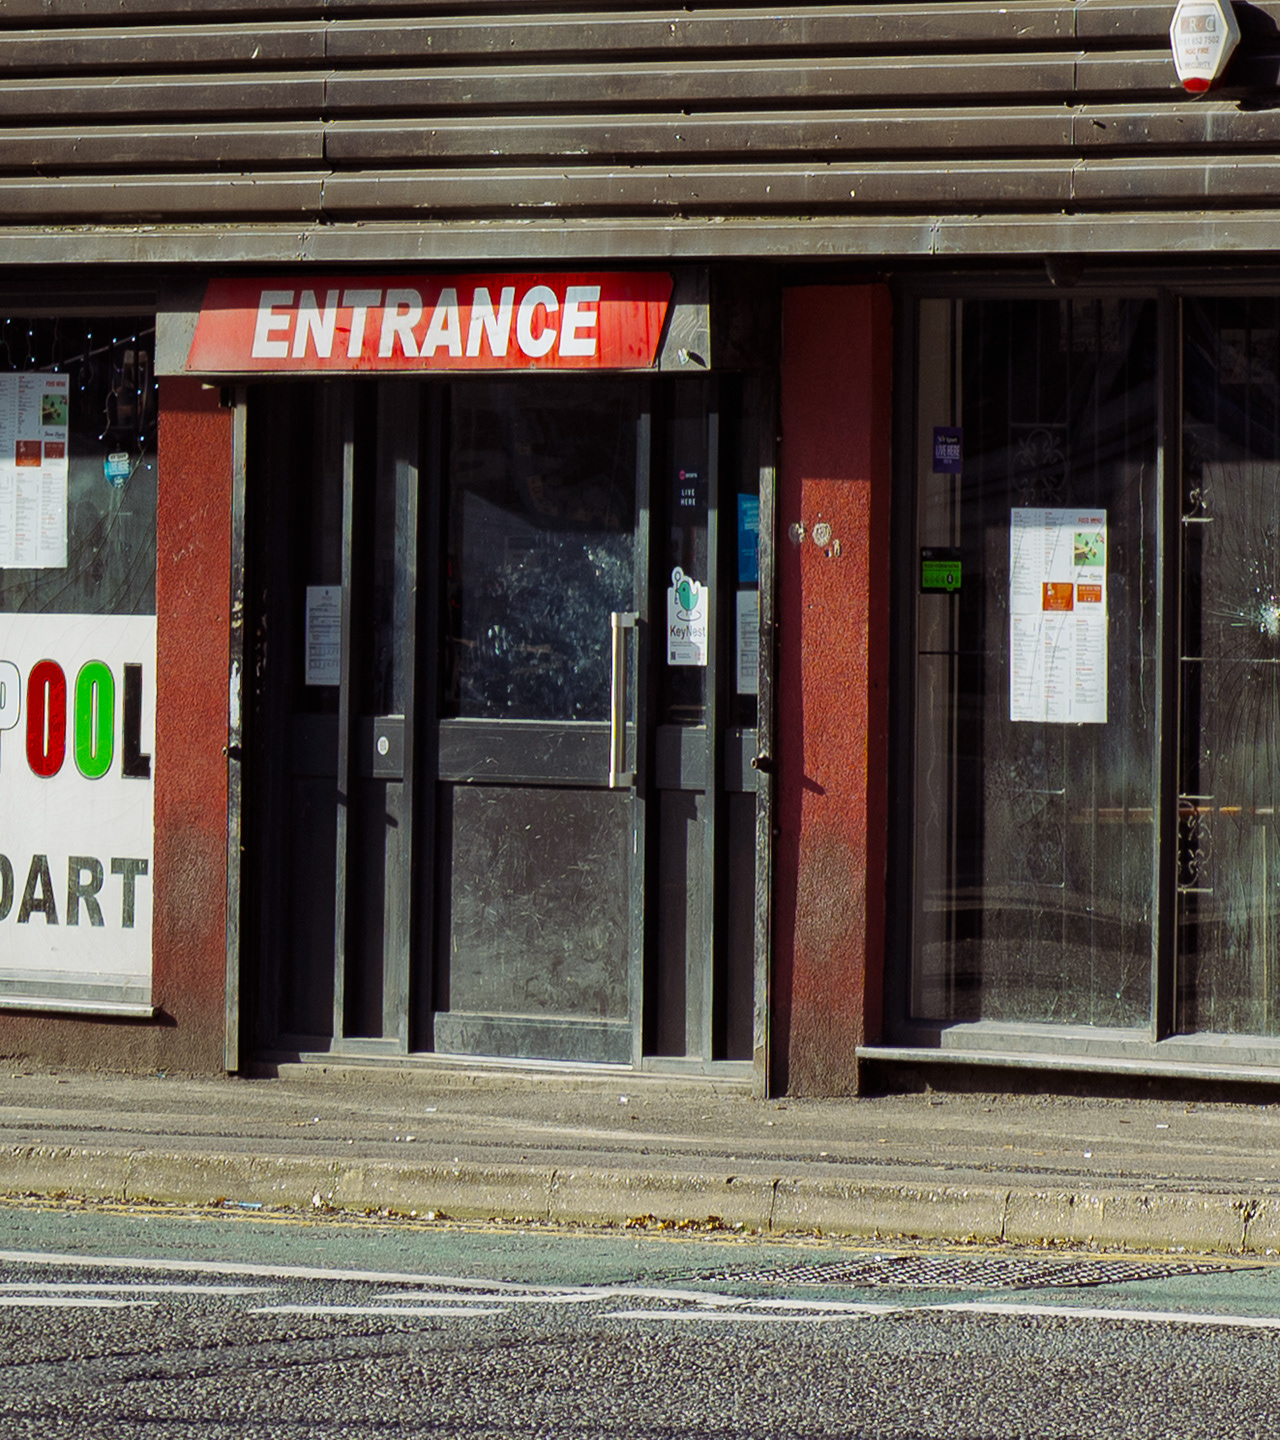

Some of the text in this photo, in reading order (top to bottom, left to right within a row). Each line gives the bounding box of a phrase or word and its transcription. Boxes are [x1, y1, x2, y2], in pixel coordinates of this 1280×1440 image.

[251, 285, 602, 359] ENTRANCE
[681, 487, 695, 497] LIVE
[680, 498, 696, 506] HERE
[670, 625, 706, 640] KeyNest
